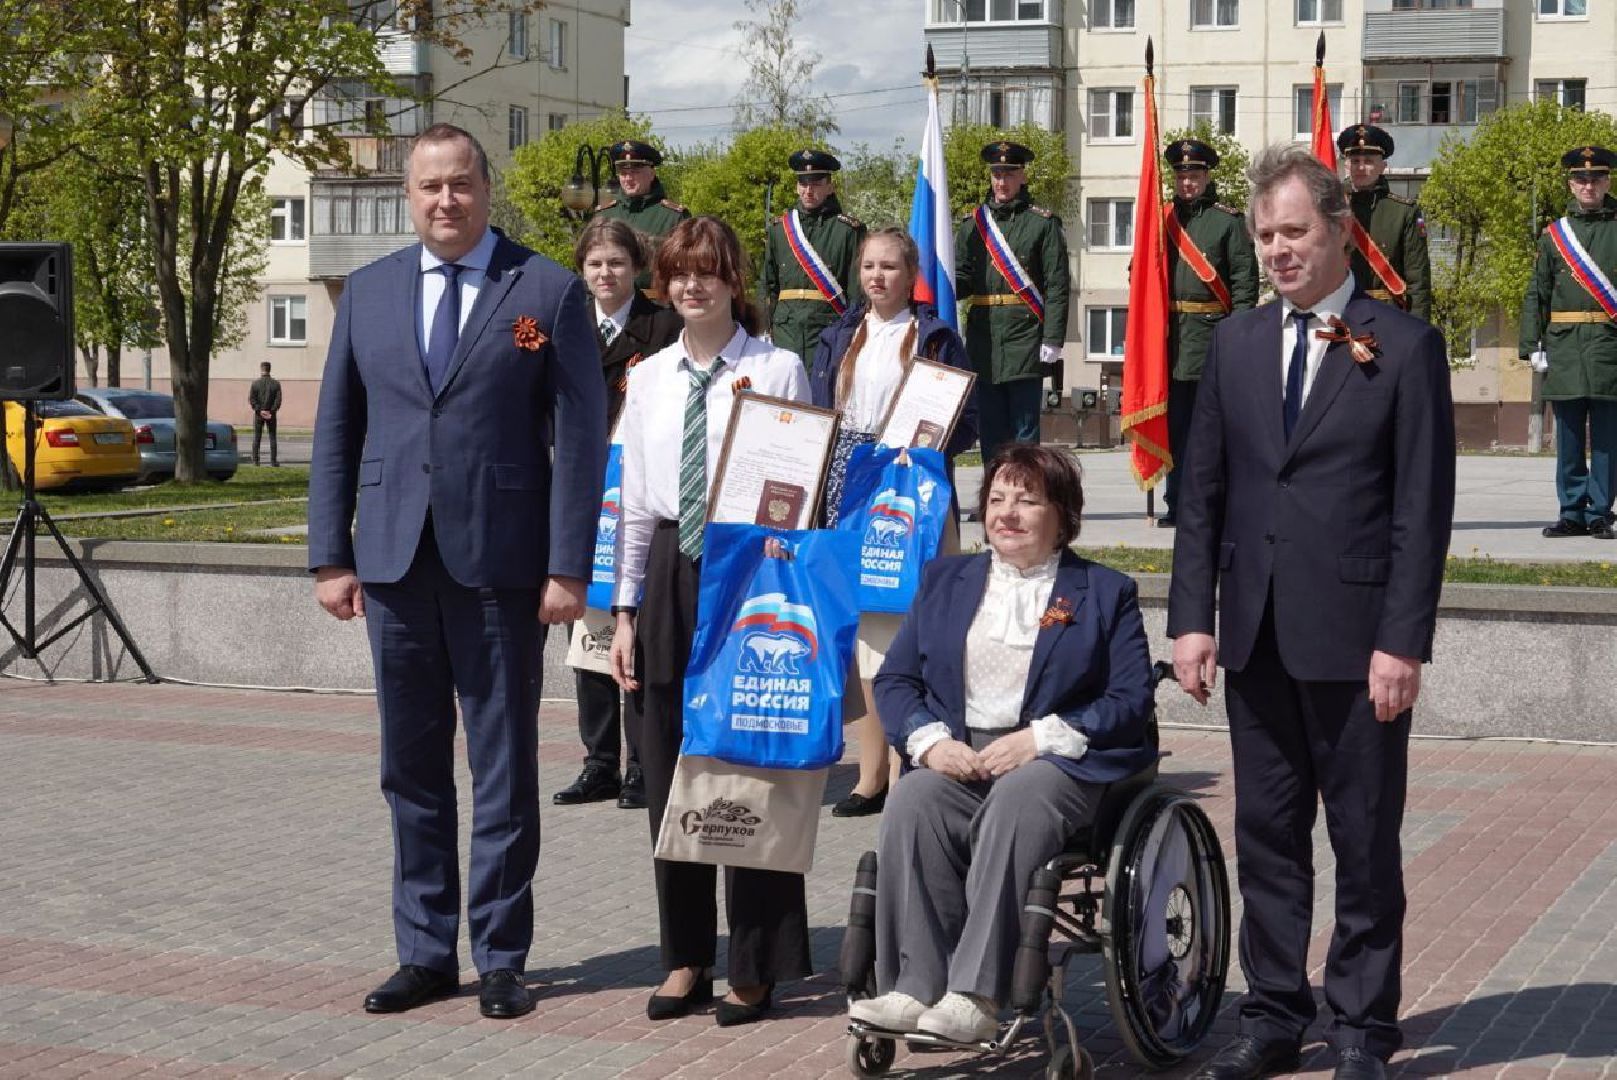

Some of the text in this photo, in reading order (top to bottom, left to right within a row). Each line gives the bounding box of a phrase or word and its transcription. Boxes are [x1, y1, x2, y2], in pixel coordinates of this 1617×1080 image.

[862, 545, 904, 560] ЕДИНАЯ
[734, 674, 811, 693] ЕДИНАЯ
[732, 692, 809, 711] РОССИЯ
[735, 717, 804, 732] ПОДМОСКОВЬЕ
[680, 810, 756, 837] Серпухов
